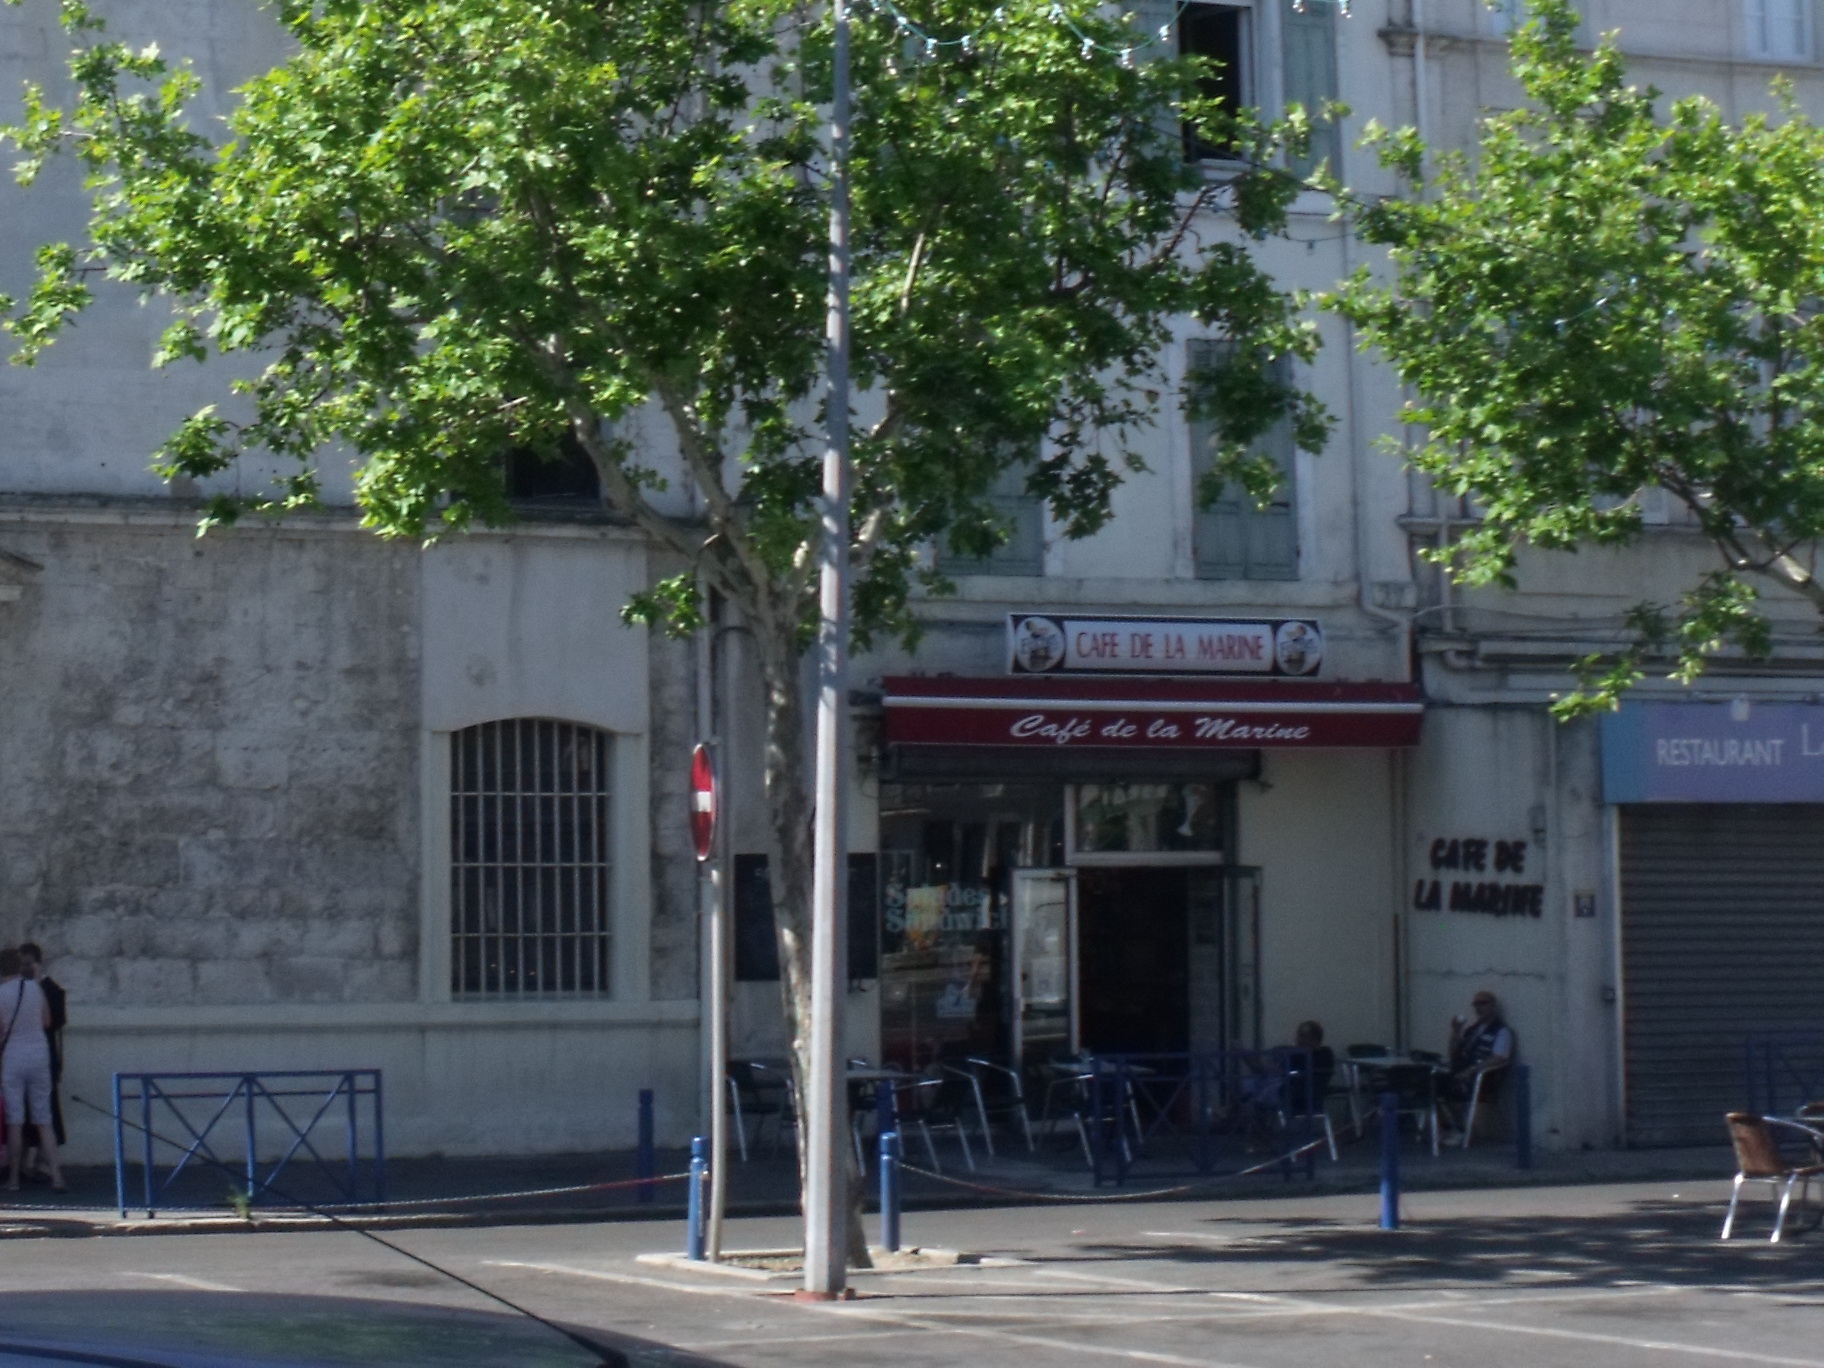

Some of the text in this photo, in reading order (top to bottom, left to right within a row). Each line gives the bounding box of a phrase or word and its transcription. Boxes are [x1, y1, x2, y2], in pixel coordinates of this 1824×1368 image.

[1076, 631, 1119, 658] CAFE
[1131, 632, 1153, 659] DE
[1164, 633, 1185, 660] LA
[1198, 634, 1263, 661] MARINE
[1010, 714, 1311, 745] Café de la Marine
[1657, 722, 1824, 766] RESTAURANT L
[1430, 837, 1527, 874] CAFE DE
[1413, 879, 1544, 919] LA MARINE
